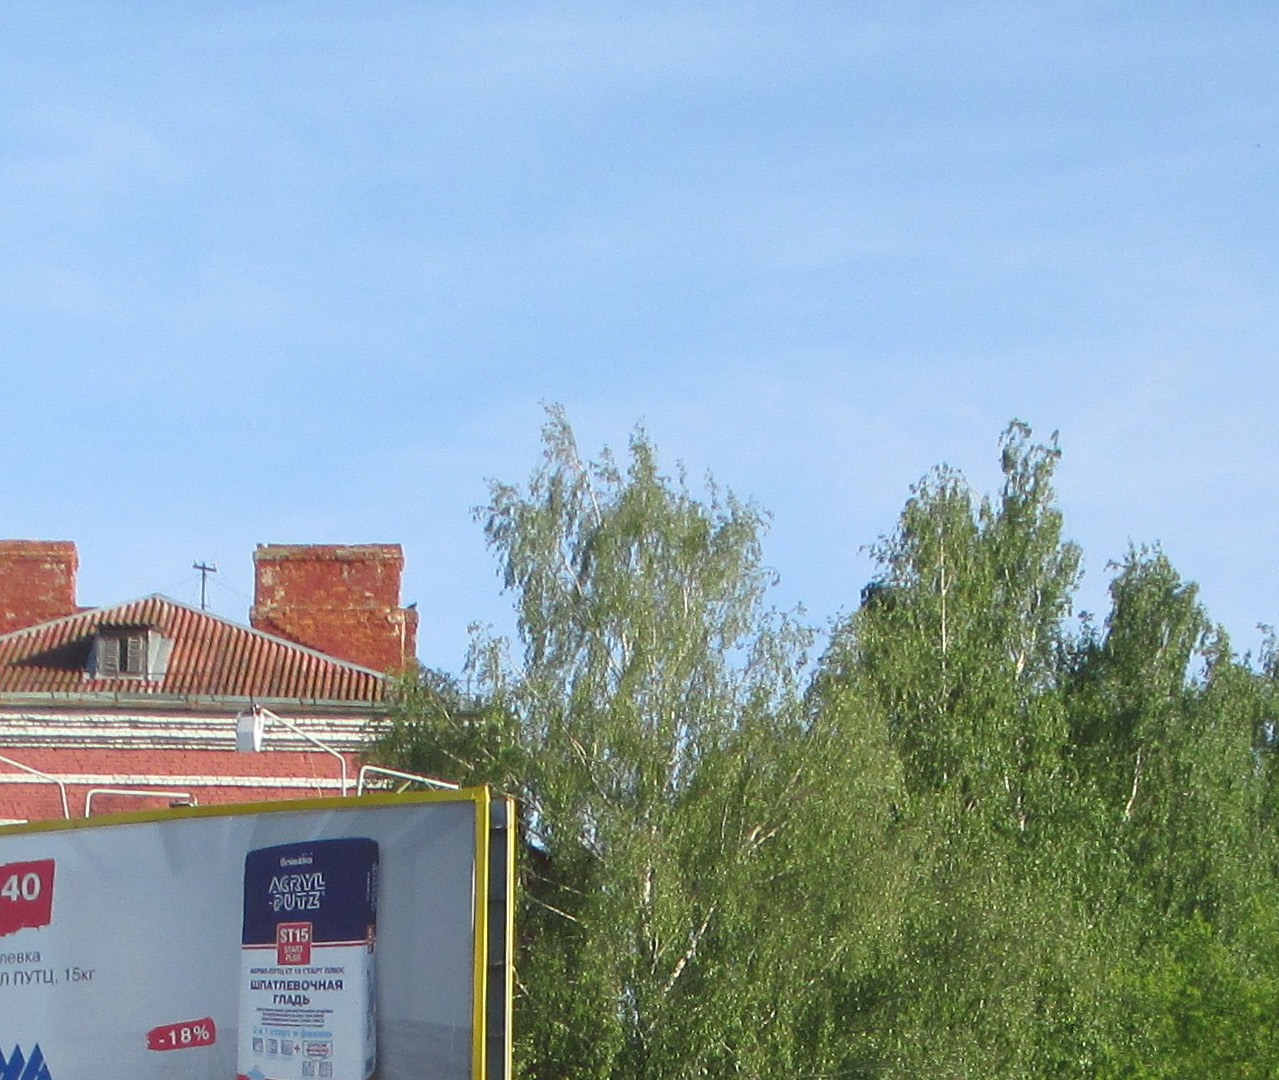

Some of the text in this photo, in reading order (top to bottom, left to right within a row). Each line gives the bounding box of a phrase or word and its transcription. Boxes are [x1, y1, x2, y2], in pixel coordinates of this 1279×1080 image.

[268, 872, 325, 893] ACRYL
[280, 927, 309, 943] ST15
[13, 969, 58, 986] ПУТЦ,
[64, 966, 95, 982] 15кг
[250, 979, 343, 991] ШПАТЛЕВОЧНАЯ
[273, 994, 310, 1007] ГЛАДЬ
[158, 1024, 210, 1046] -18%
